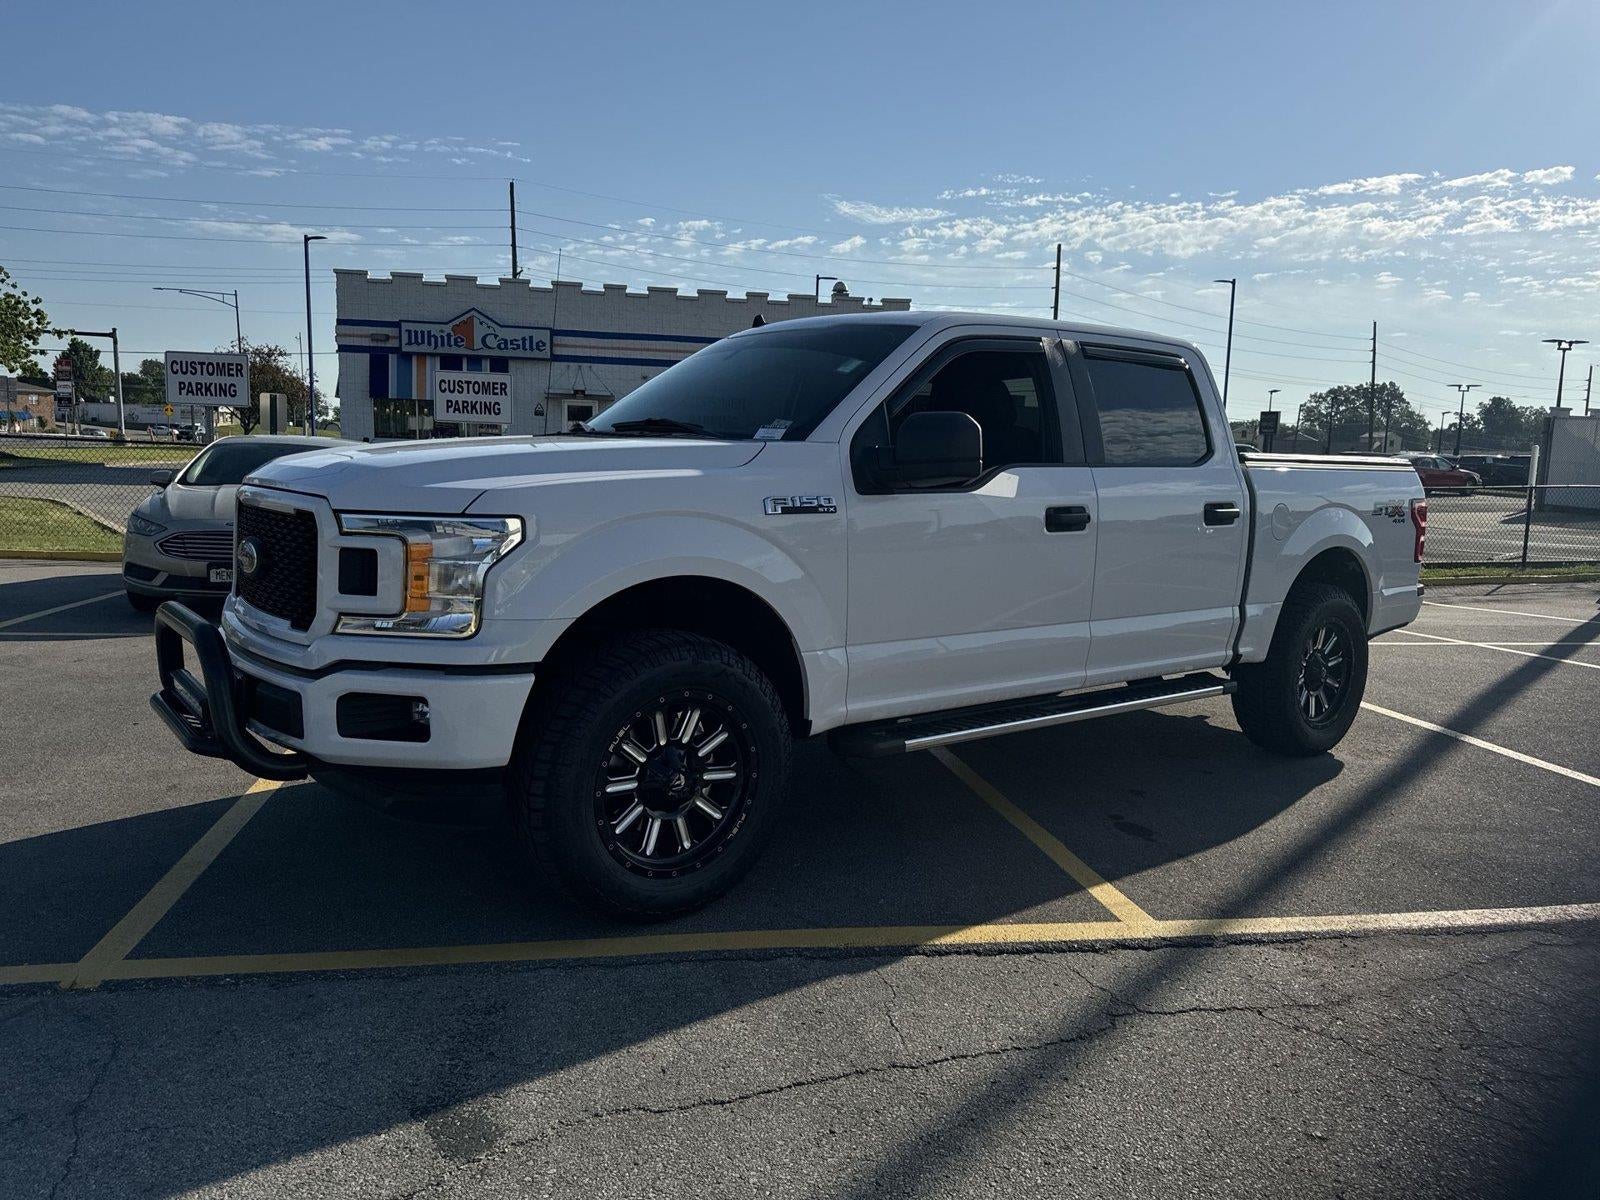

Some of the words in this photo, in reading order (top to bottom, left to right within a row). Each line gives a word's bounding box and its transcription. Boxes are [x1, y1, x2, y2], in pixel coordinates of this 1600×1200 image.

[404, 329, 465, 350] White
[481, 333, 546, 351] Castle
[170, 360, 244, 378] CUSTOMER
[178, 381, 237, 398] PARKING
[439, 379, 508, 396] CUSTOMER
[446, 399, 502, 415] PARKING
[608, 724, 630, 752] FUEL
[727, 813, 746, 840] FUEL
